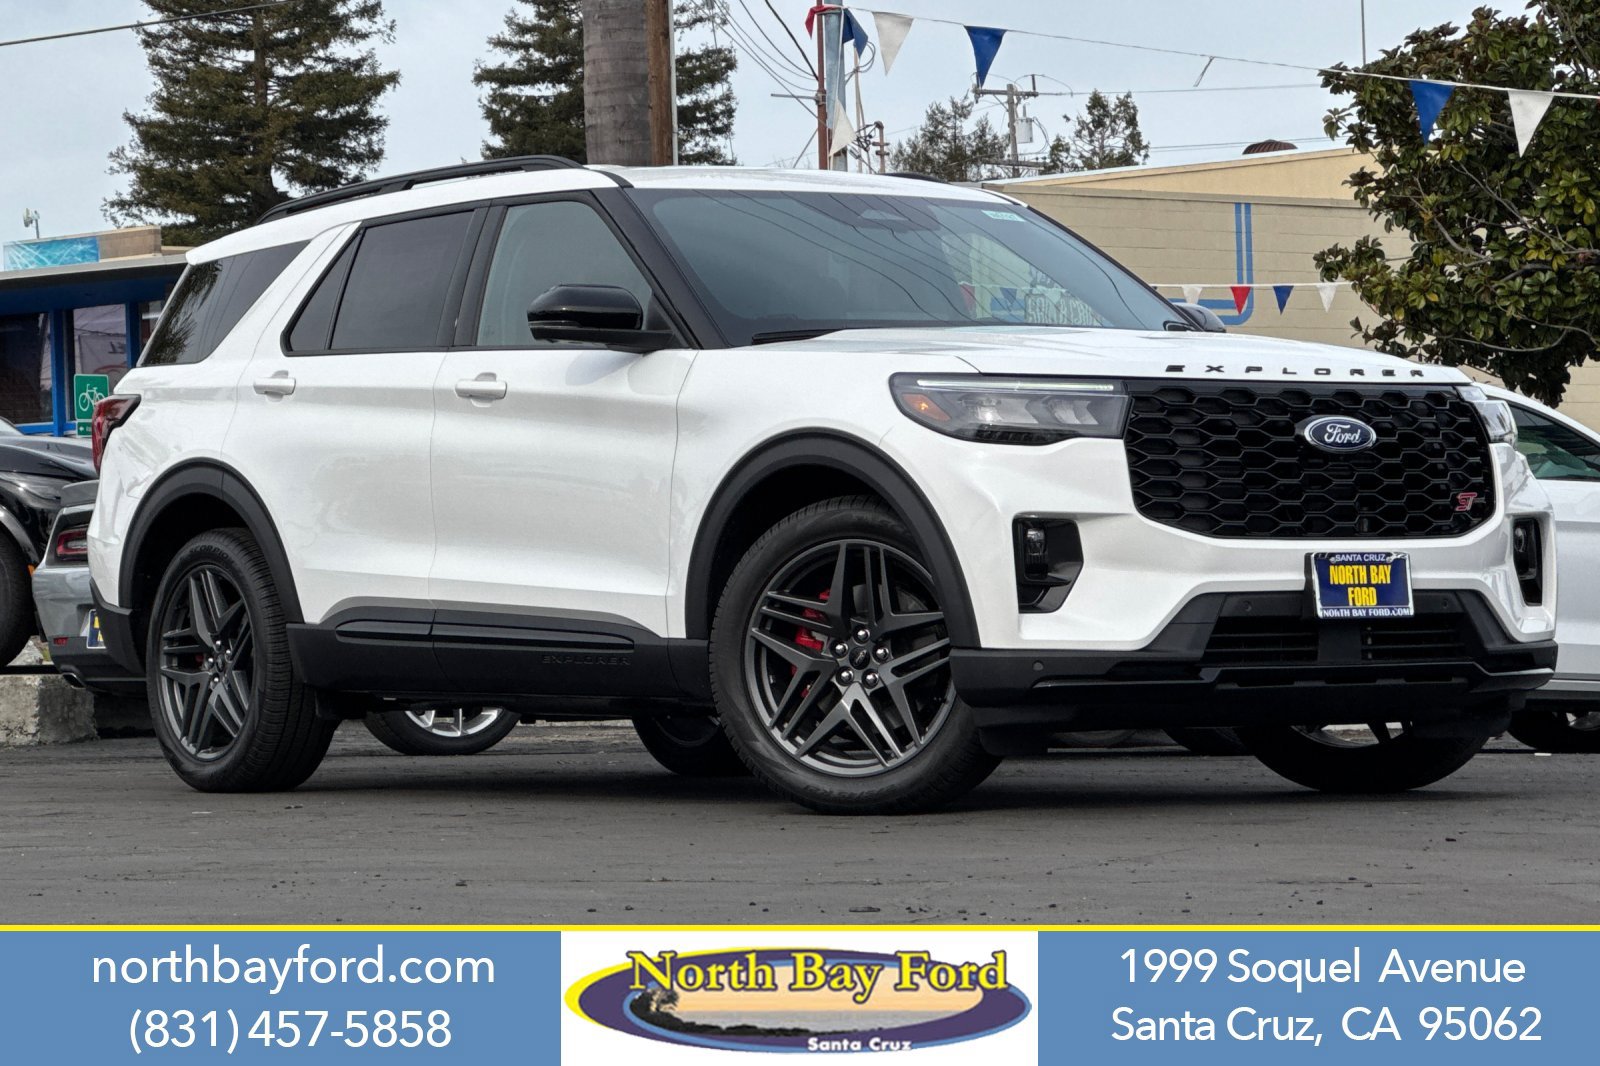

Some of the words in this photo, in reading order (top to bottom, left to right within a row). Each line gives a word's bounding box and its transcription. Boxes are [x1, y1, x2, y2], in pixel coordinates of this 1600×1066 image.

[1165, 365, 1424, 377] EXPLORER
[1324, 423, 1361, 443] Ford
[1335, 554, 1362, 562] SANTA
[1363, 553, 1386, 561] CRUZ
[1329, 565, 1367, 585] NORTH
[1370, 565, 1391, 584] BAY
[1348, 587, 1377, 606] FORD
[1323, 609, 1350, 618] NORTH
[1352, 608, 1367, 617] BAY
[1369, 607, 1410, 616] FORD.COM
[542, 655, 631, 665] EXPLORER
